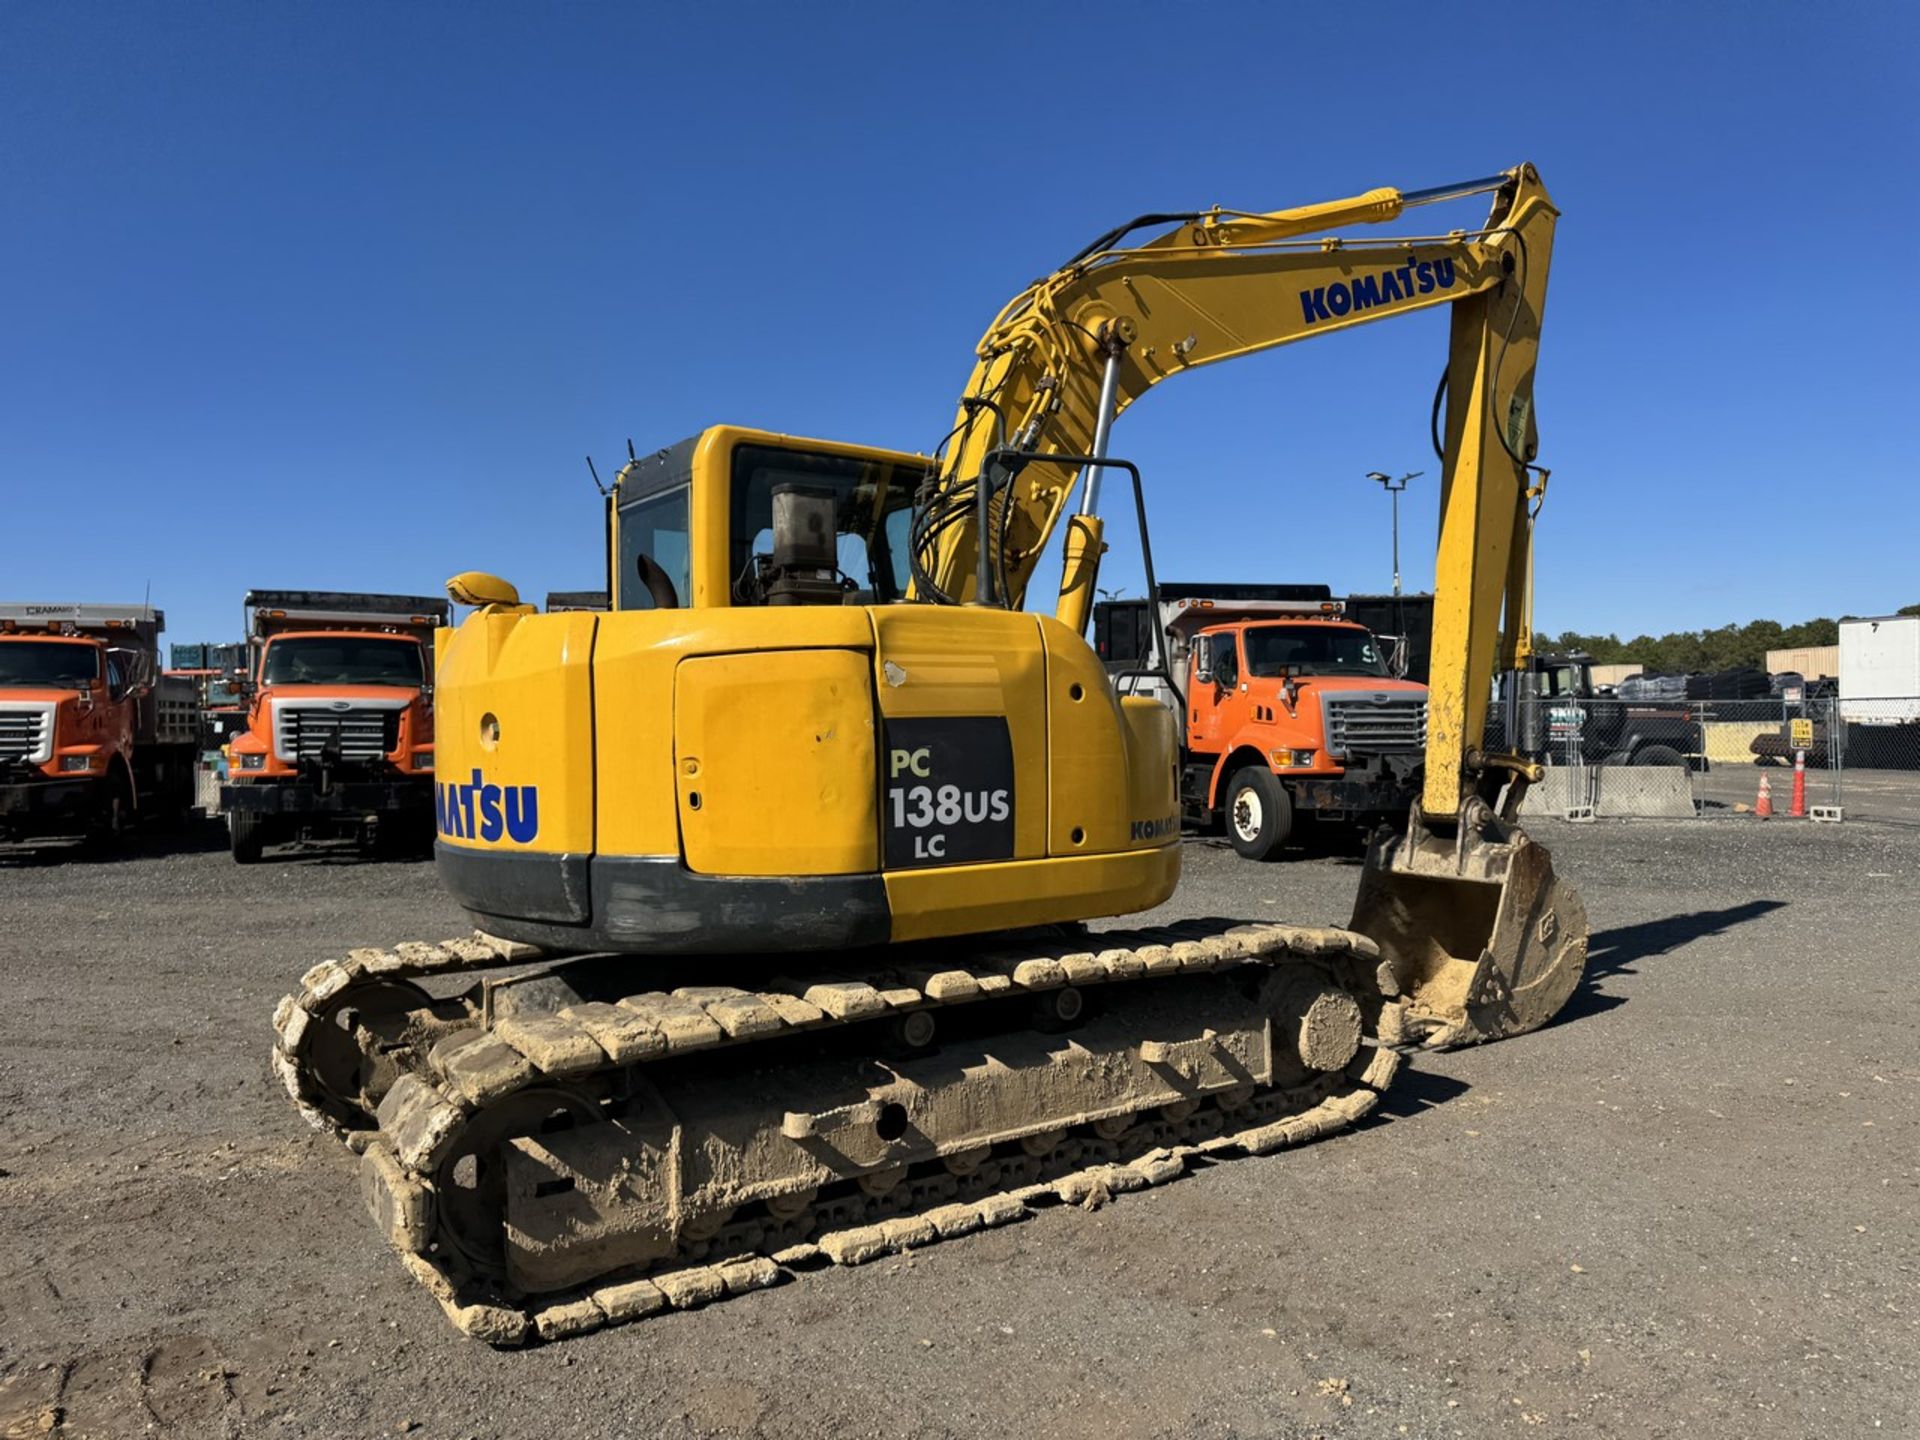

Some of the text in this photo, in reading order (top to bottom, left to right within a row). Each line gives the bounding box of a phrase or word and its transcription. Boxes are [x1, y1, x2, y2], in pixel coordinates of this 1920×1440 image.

[1300, 256, 1456, 324] KOMATSU
[890, 748, 930, 778] PC
[889, 784, 1010, 828] 138US
[914, 834, 946, 859] LC
